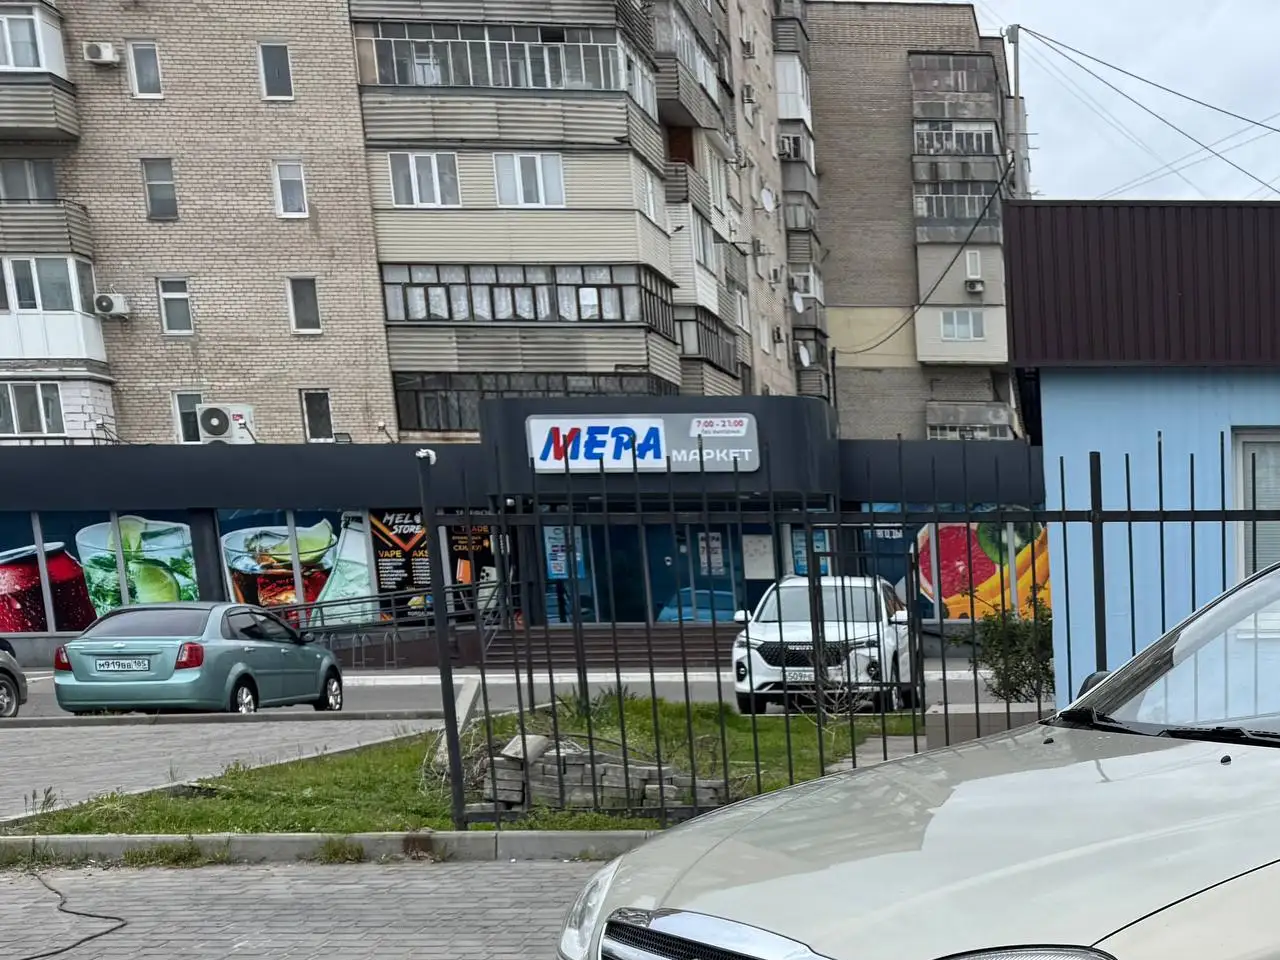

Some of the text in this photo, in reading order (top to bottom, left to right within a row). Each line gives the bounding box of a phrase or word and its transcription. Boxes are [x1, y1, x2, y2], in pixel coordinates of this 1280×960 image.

[540, 426, 662, 461] МЕРА
[671, 449, 752, 462] МАРКЕТ
[391, 524, 422, 534] STORE
[378, 550, 402, 558] VAPE
